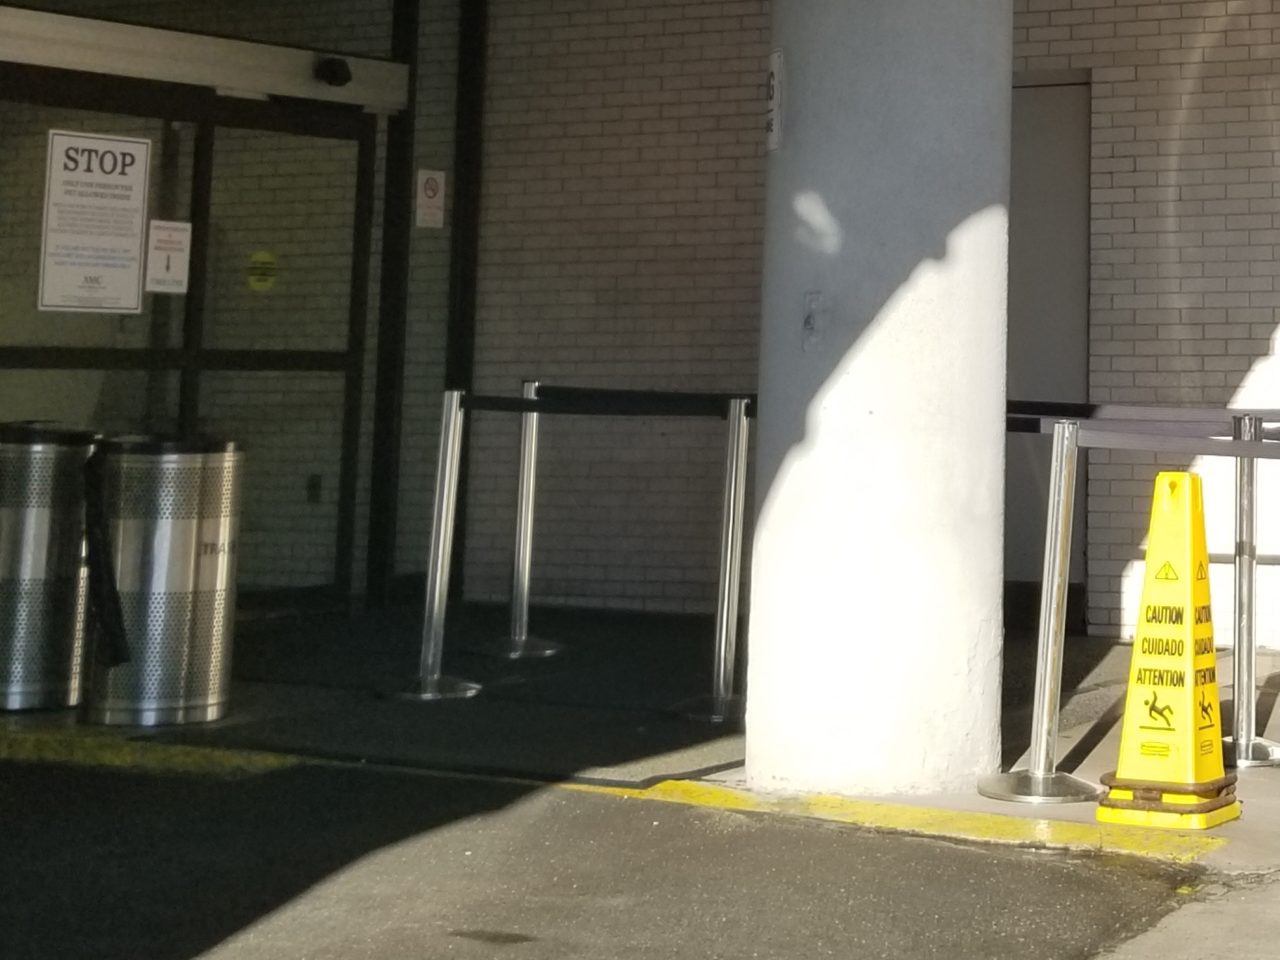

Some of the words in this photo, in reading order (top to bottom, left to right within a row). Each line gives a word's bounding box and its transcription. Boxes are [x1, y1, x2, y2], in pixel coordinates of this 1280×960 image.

[63, 146, 136, 176] STOP
[1146, 605, 1184, 626] CAUTION
[1141, 637, 1184, 657] CUIDADO
[1136, 668, 1186, 688] ATTENTION
